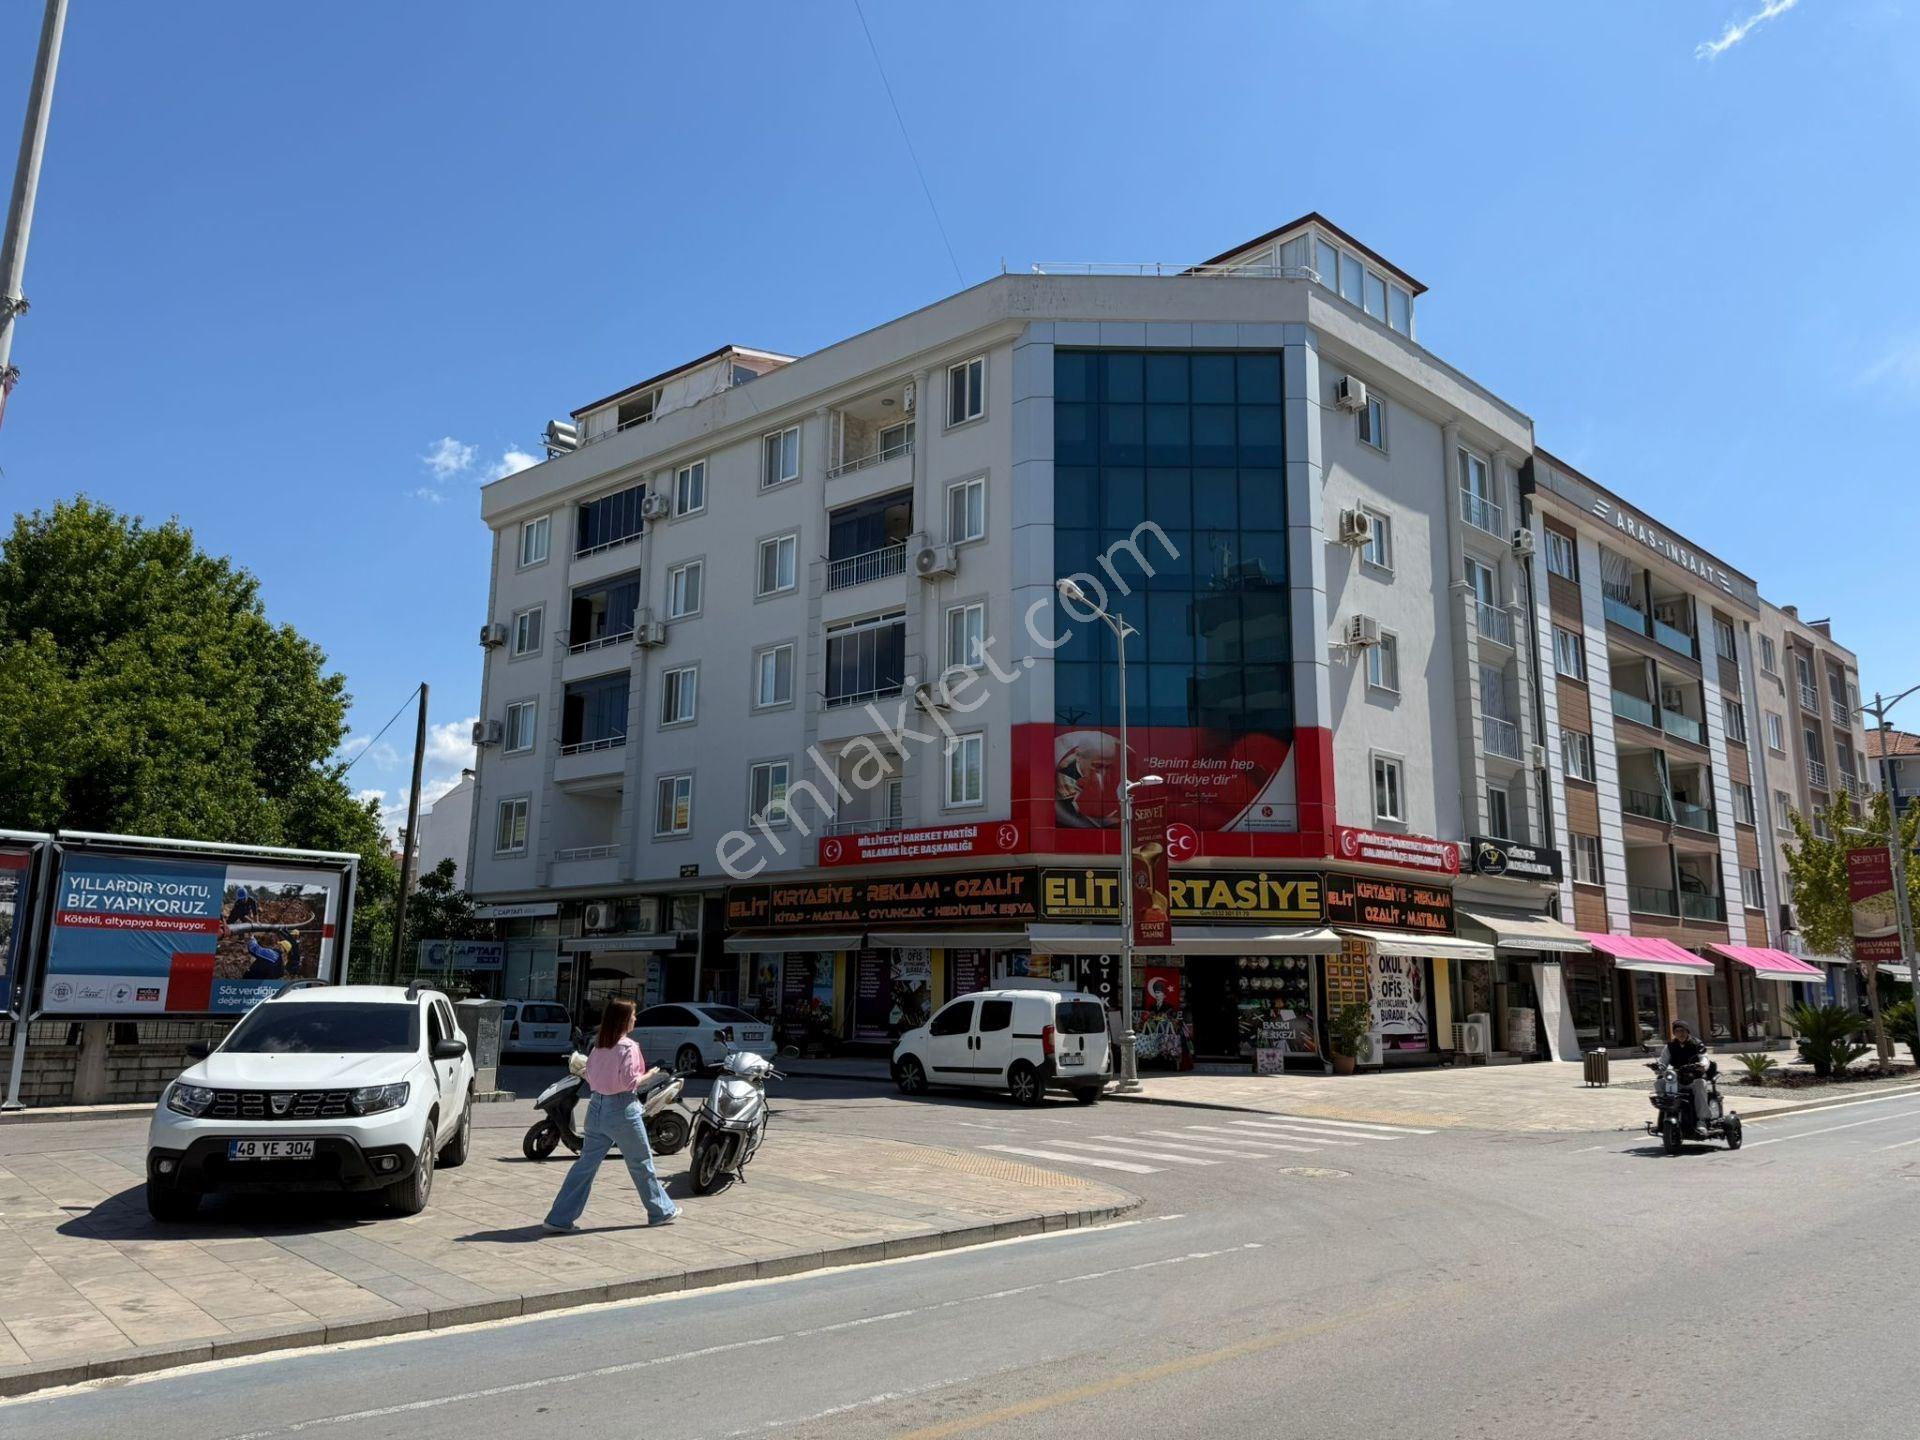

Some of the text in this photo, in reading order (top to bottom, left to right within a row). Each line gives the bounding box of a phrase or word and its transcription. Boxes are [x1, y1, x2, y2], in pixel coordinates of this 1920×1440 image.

[1192, 757, 1227, 769] aklım
[1230, 758, 1255, 770] hep
[1134, 805, 1164, 821] SERVET
[858, 826, 978, 847] MİLLİYETÇİ HAREKET PARTİSİ
[861, 840, 973, 859] DALAMAN İLÇE BAŞKANLIĞI
[1850, 853, 1886, 865] SERVET
[70, 876, 211, 899] YILLARDIR YOKTU,
[773, 883, 854, 906] KIRTASİYE
[866, 881, 940, 901] REKLAM
[954, 873, 1024, 897] OZALİT
[1045, 870, 1320, 909] ELİT RTASİYE
[1357, 882, 1407, 902] KIRTASİYE
[1413, 889, 1451, 907] REKLAM
[67, 891, 208, 915] BİZ YAPIYORUZ.
[1328, 889, 1354, 906] ELİT
[728, 896, 769, 917] ELİT
[868, 906, 925, 919] OYUNCAK
[999, 902, 1035, 916] EŞYA
[64, 914, 207, 931] Kötekli, altyapıya kavuşuyor.
[1364, 905, 1400, 923] OZALİT
[1407, 911, 1447, 928] MATBAA
[1379, 956, 1403, 974] OKUL
[219, 985, 237, 995] Söz
[1381, 981, 1403, 998] OFİS
[1262, 1021, 1290, 1030] BASKI
[237, 1142, 312, 1155] 48 YE 304
